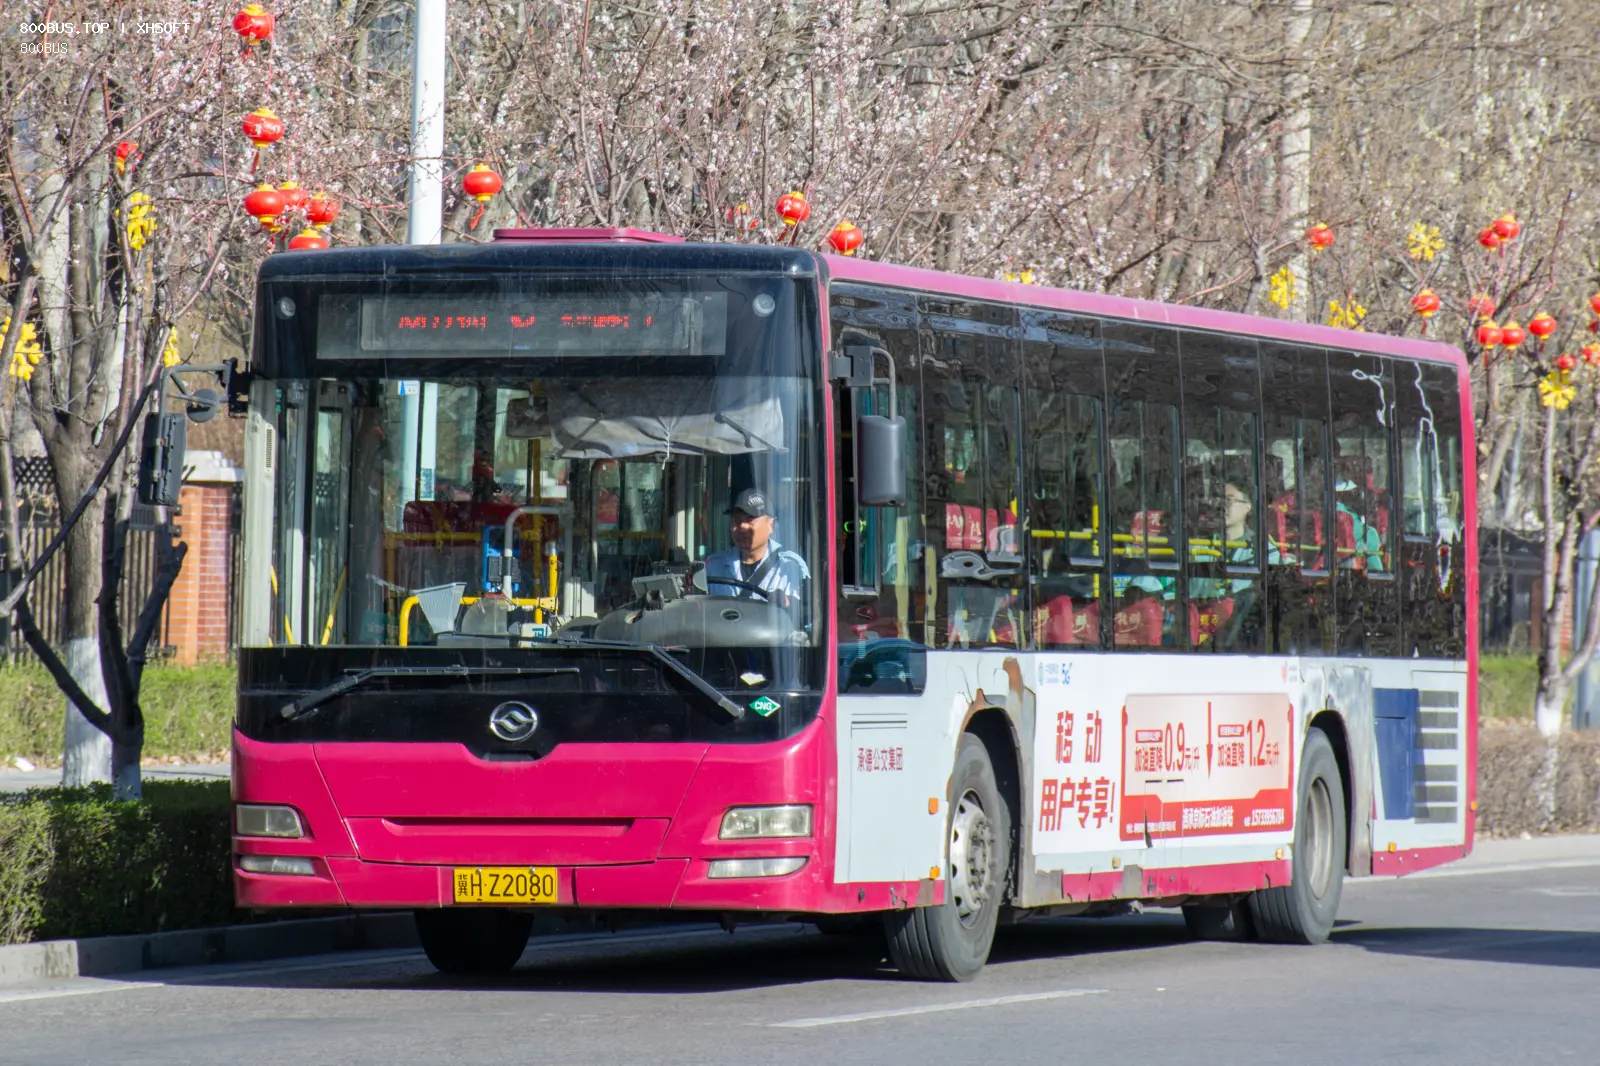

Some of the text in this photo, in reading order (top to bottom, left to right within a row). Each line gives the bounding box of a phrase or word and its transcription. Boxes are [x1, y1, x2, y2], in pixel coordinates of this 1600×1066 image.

[754, 701, 773, 711] CNG
[1055, 709, 1103, 764] 移动
[857, 746, 904, 772] 承德公交集团
